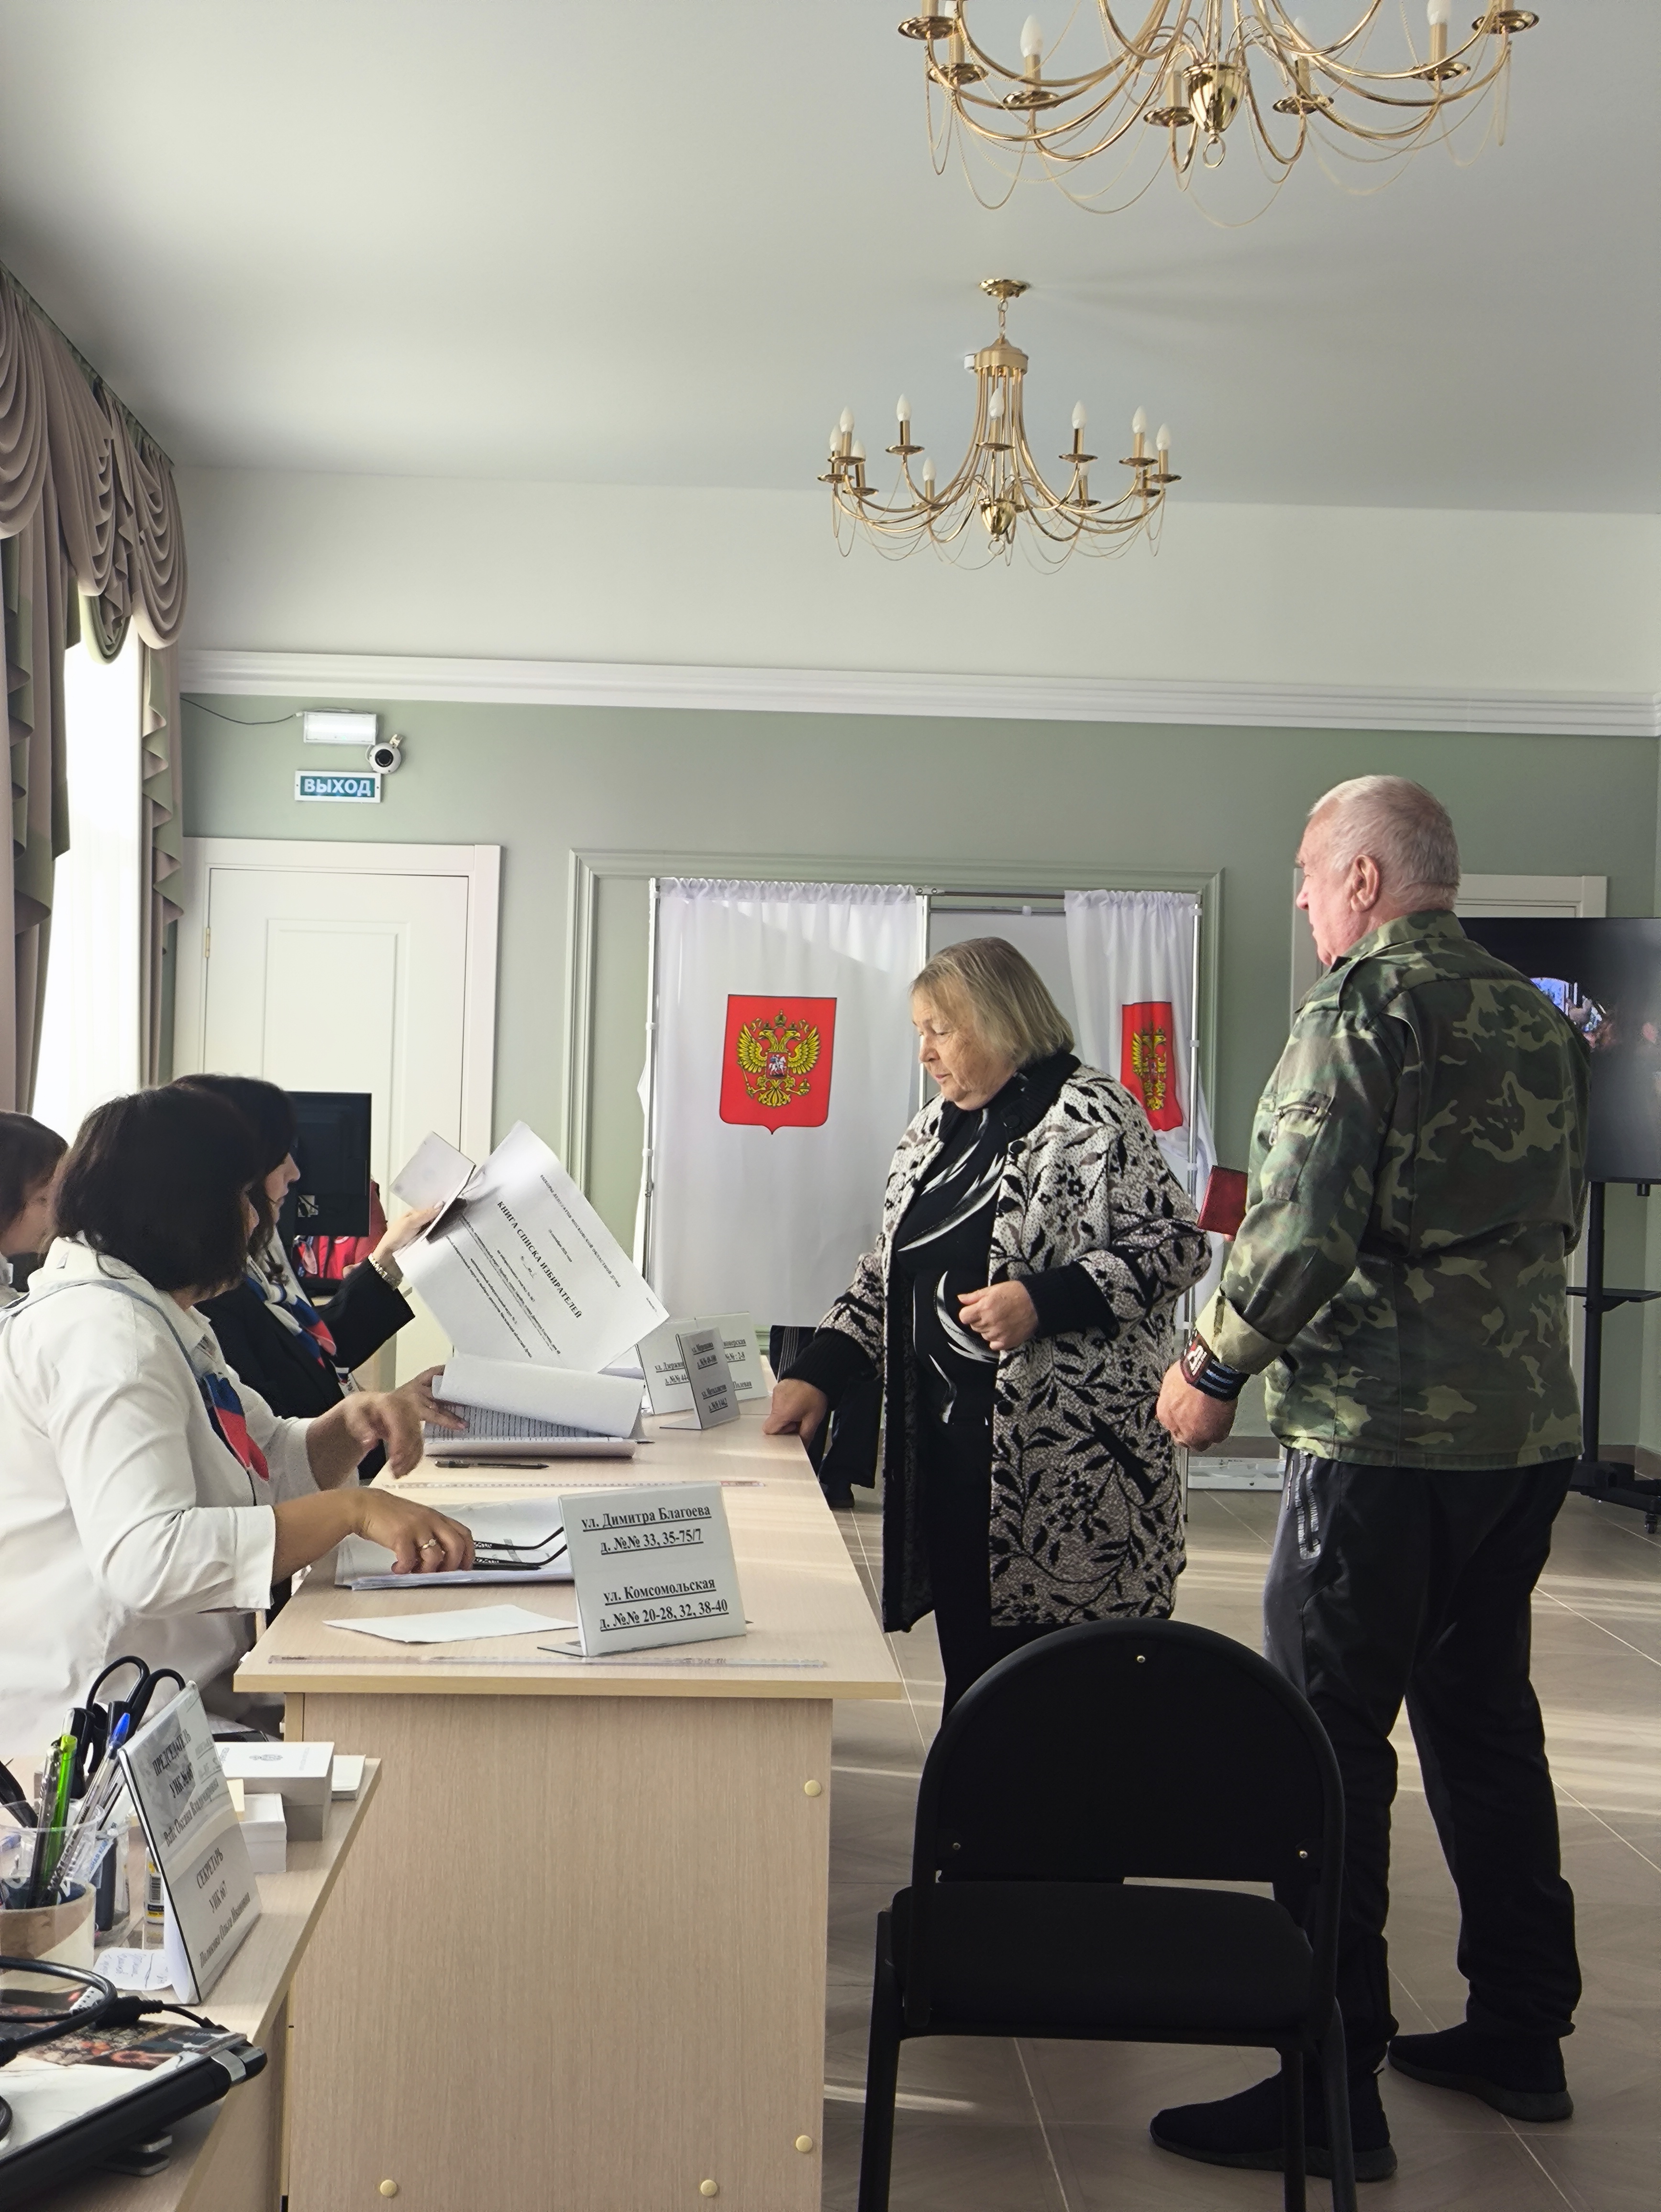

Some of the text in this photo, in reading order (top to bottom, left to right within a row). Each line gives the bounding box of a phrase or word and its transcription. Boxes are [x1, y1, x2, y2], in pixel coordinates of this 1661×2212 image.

[304, 779, 371, 796] ВЫХОД
[496, 1200, 519, 1229] КНИГА
[515, 1228, 543, 1262] СПИСКА
[539, 1261, 583, 1318] ИЗБИРАТЕЛЕЙ
[581, 1506, 710, 1529] ул. Димитра Благоева
[600, 1528, 701, 1554] д. №№ 33, 35-75/7
[603, 1579, 716, 1603] ул. Комсомольская
[599, 1598, 728, 1630] д. №№ 20-28, 32, 38-40
[152, 1728, 191, 1777] ПРЕДСЕДАТЕЛЬ
[197, 1847, 223, 1889] СЕКРЕТАРЬ
